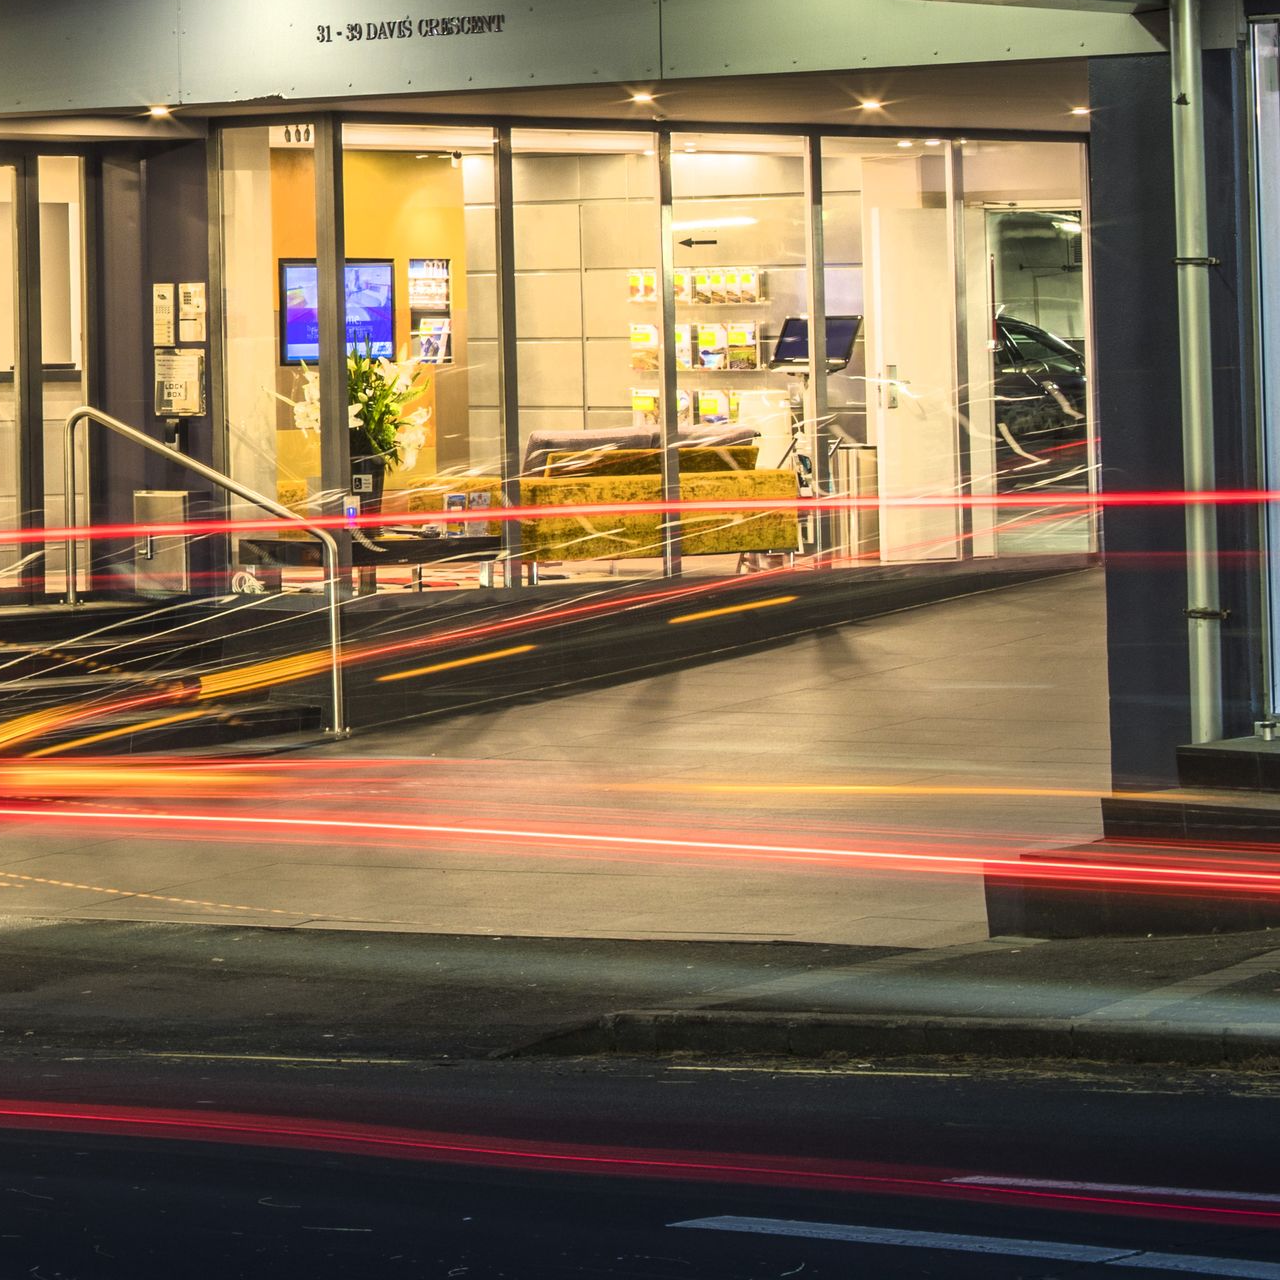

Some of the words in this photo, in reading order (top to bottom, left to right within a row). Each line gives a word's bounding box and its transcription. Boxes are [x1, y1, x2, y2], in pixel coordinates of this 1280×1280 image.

[316, 24, 333, 43] 31
[345, 23, 363, 42] 39
[366, 18, 413, 40] DAVIS
[417, 13, 506, 37] CRESCENT
